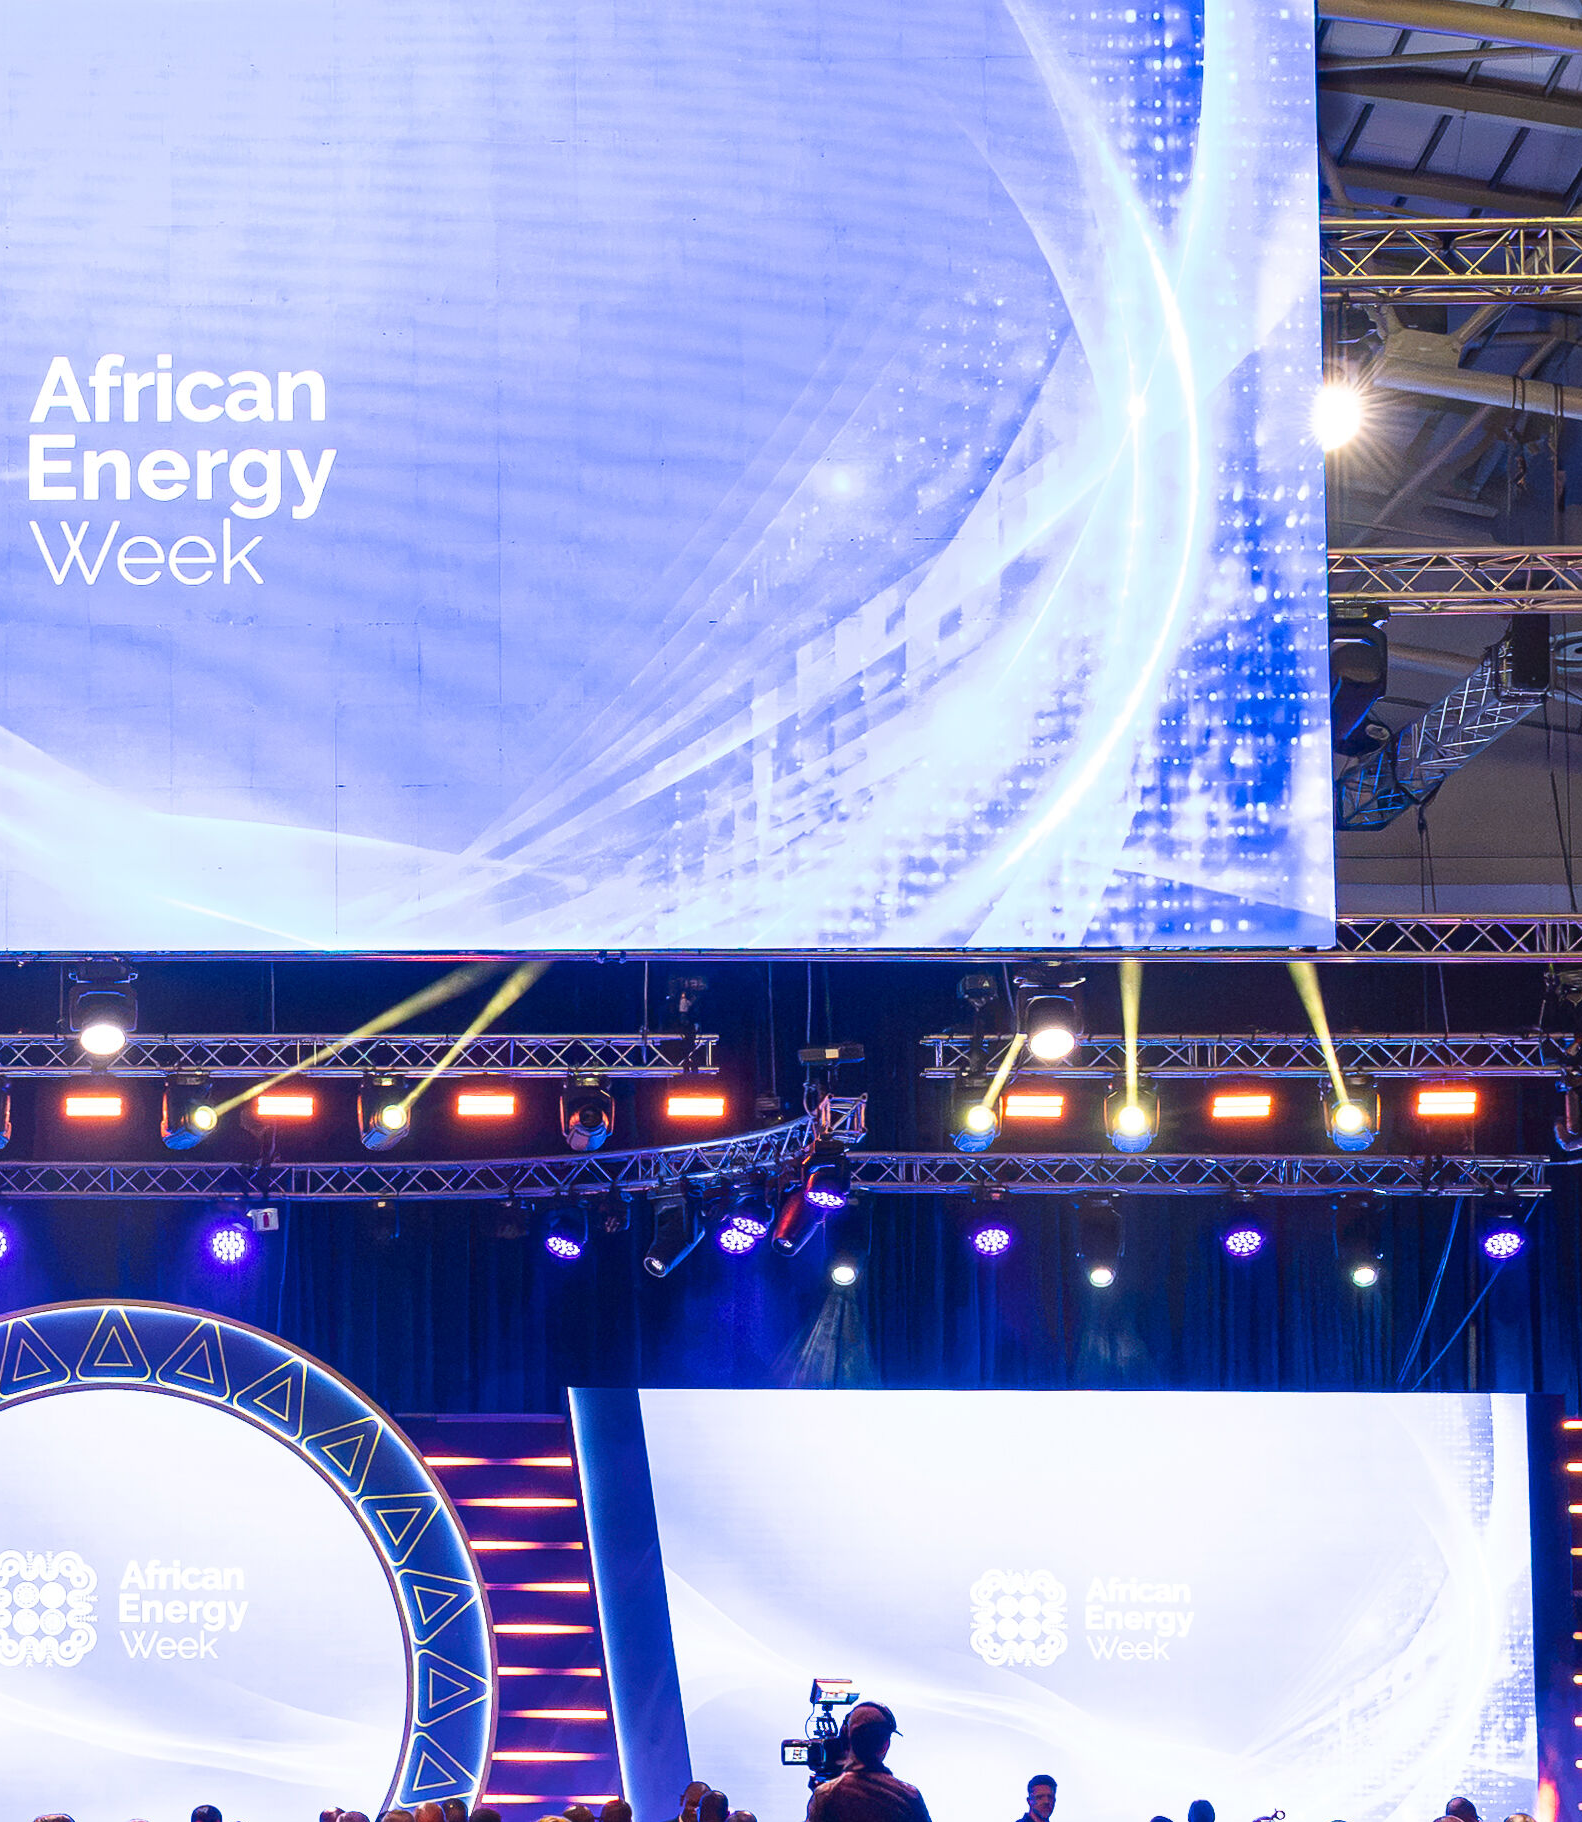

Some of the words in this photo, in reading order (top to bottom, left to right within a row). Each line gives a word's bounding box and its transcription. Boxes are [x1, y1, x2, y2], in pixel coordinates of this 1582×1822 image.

[29, 353, 327, 424] African
[28, 433, 338, 520] Energy
[28, 517, 265, 587] Week
[119, 1559, 245, 1591] African
[1085, 1575, 1192, 1604] African
[118, 1593, 249, 1632] Energy
[1084, 1605, 1195, 1638] Energy
[119, 1629, 219, 1660] Week
[1086, 1635, 1171, 1661] Week
